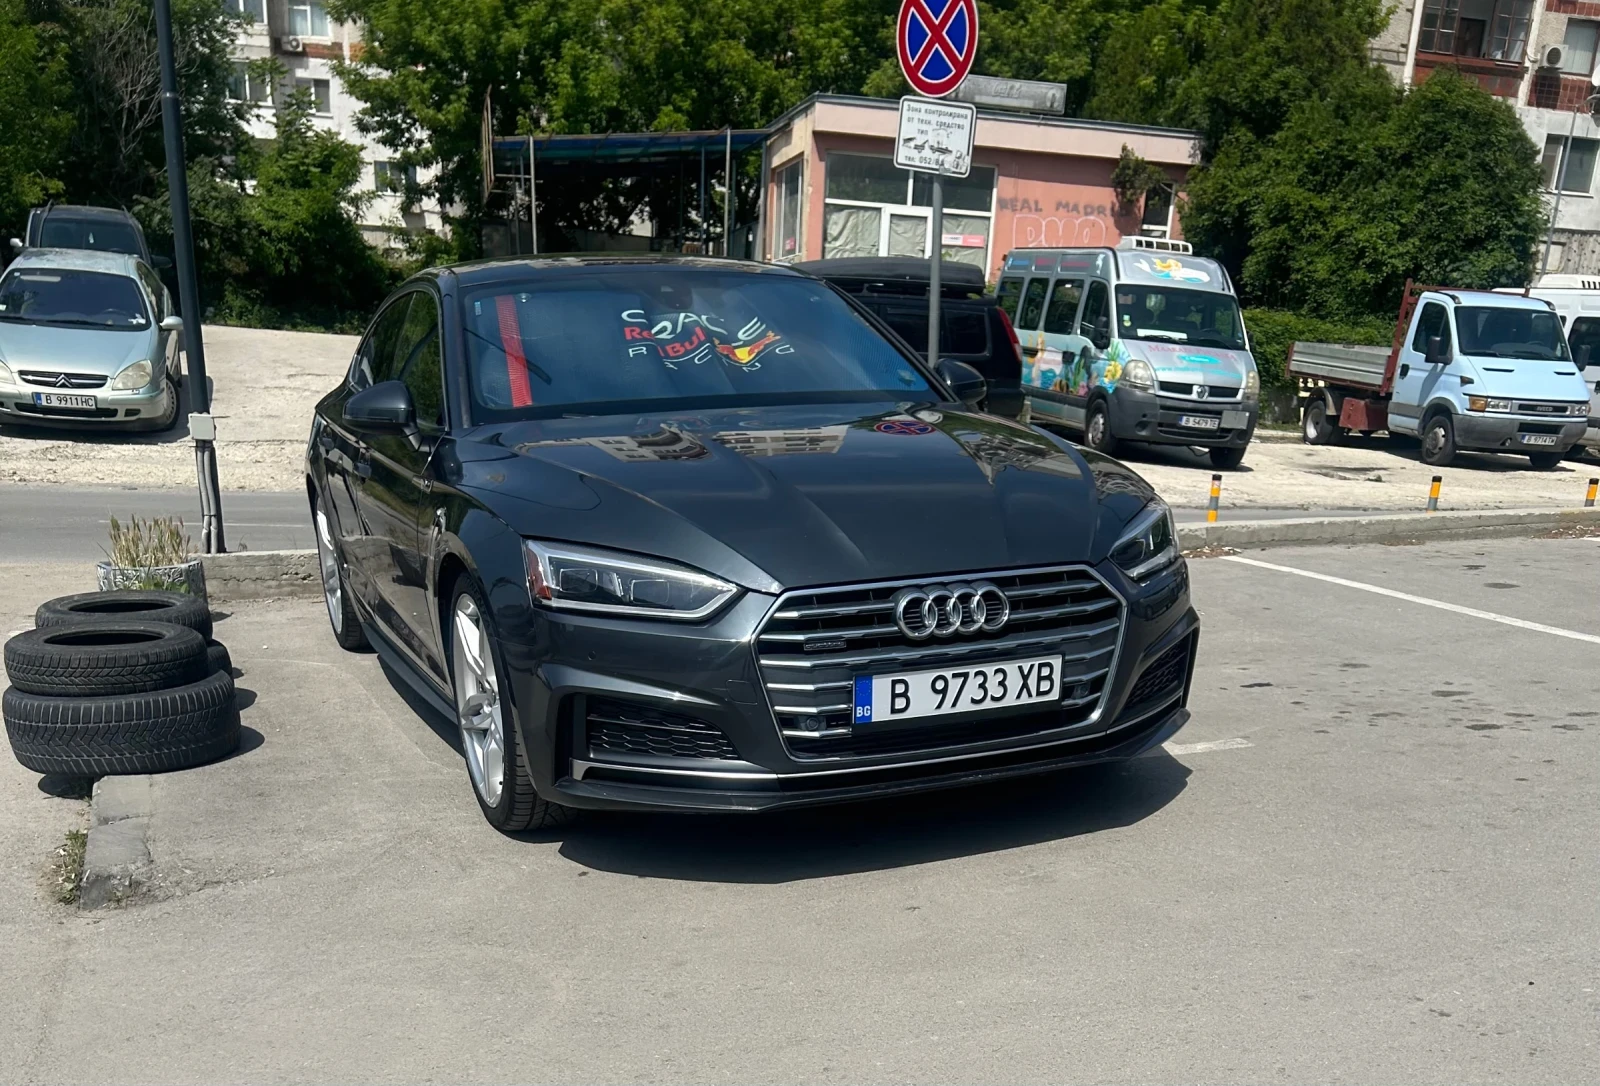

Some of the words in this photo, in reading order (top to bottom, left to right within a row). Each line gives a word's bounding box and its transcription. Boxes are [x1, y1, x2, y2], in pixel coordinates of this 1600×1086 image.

[906, 104, 922, 114] Зона
[924, 108, 968, 120] контролирана
[935, 120, 965, 130] средство
[999, 196, 1043, 213] REAL
[45, 395, 52, 405] B
[56, 395, 79, 406] 9911
[81, 397, 94, 407] HC
[890, 678, 911, 715] B
[930, 667, 1008, 710] 9733
[1015, 661, 1055, 699] XB
[856, 706, 871, 717] BG
